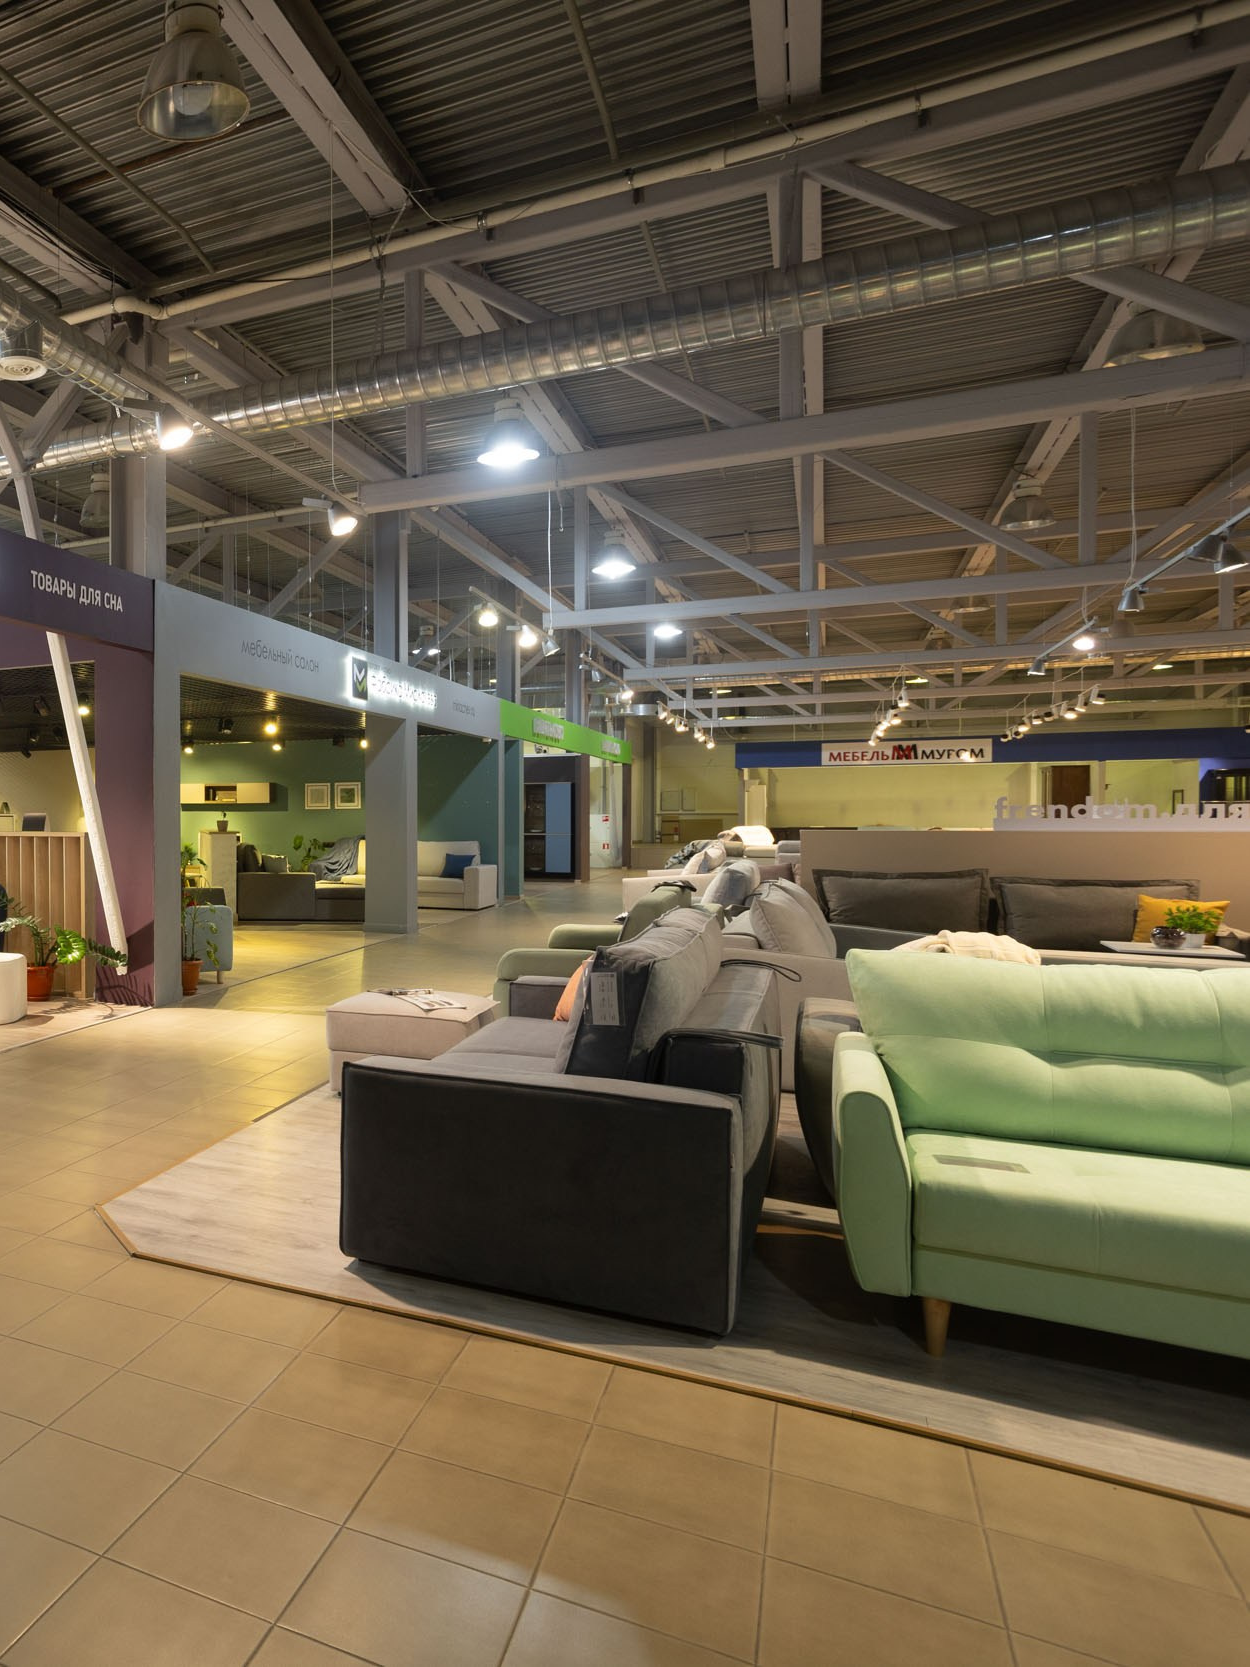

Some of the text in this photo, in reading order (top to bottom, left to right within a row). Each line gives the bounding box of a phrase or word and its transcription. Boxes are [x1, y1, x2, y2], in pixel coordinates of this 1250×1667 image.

[30, 569, 123, 613] ТОВАРЫ ДЛЯ СНА
[241, 640, 320, 673] мебельный салон
[829, 749, 890, 762] МЕБЕЛЬ
